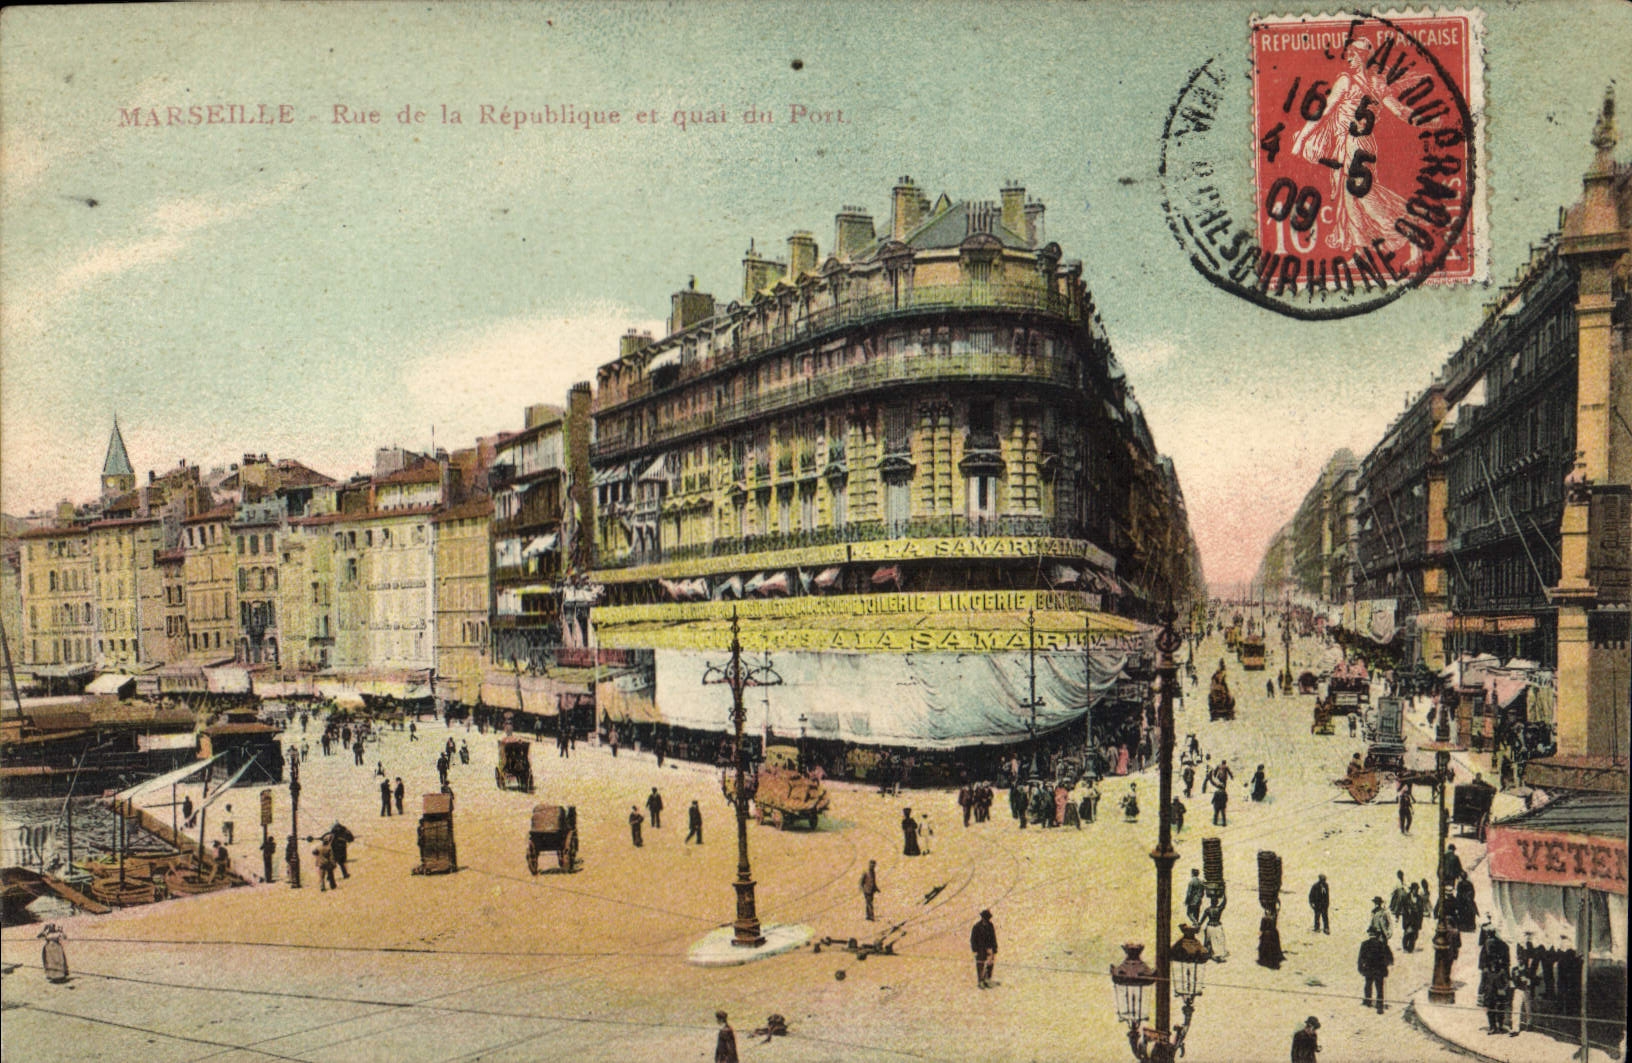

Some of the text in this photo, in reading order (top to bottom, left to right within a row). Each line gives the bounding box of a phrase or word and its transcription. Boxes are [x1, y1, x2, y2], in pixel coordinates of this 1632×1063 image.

[1261, 31, 1349, 52] REPUBLIQUE
[1283, 76, 1331, 121] 16
[1266, 177, 1323, 232] 09
[938, 591, 1025, 611] LINGERIE
[829, 631, 854, 650] A
[854, 631, 903, 650] LA
